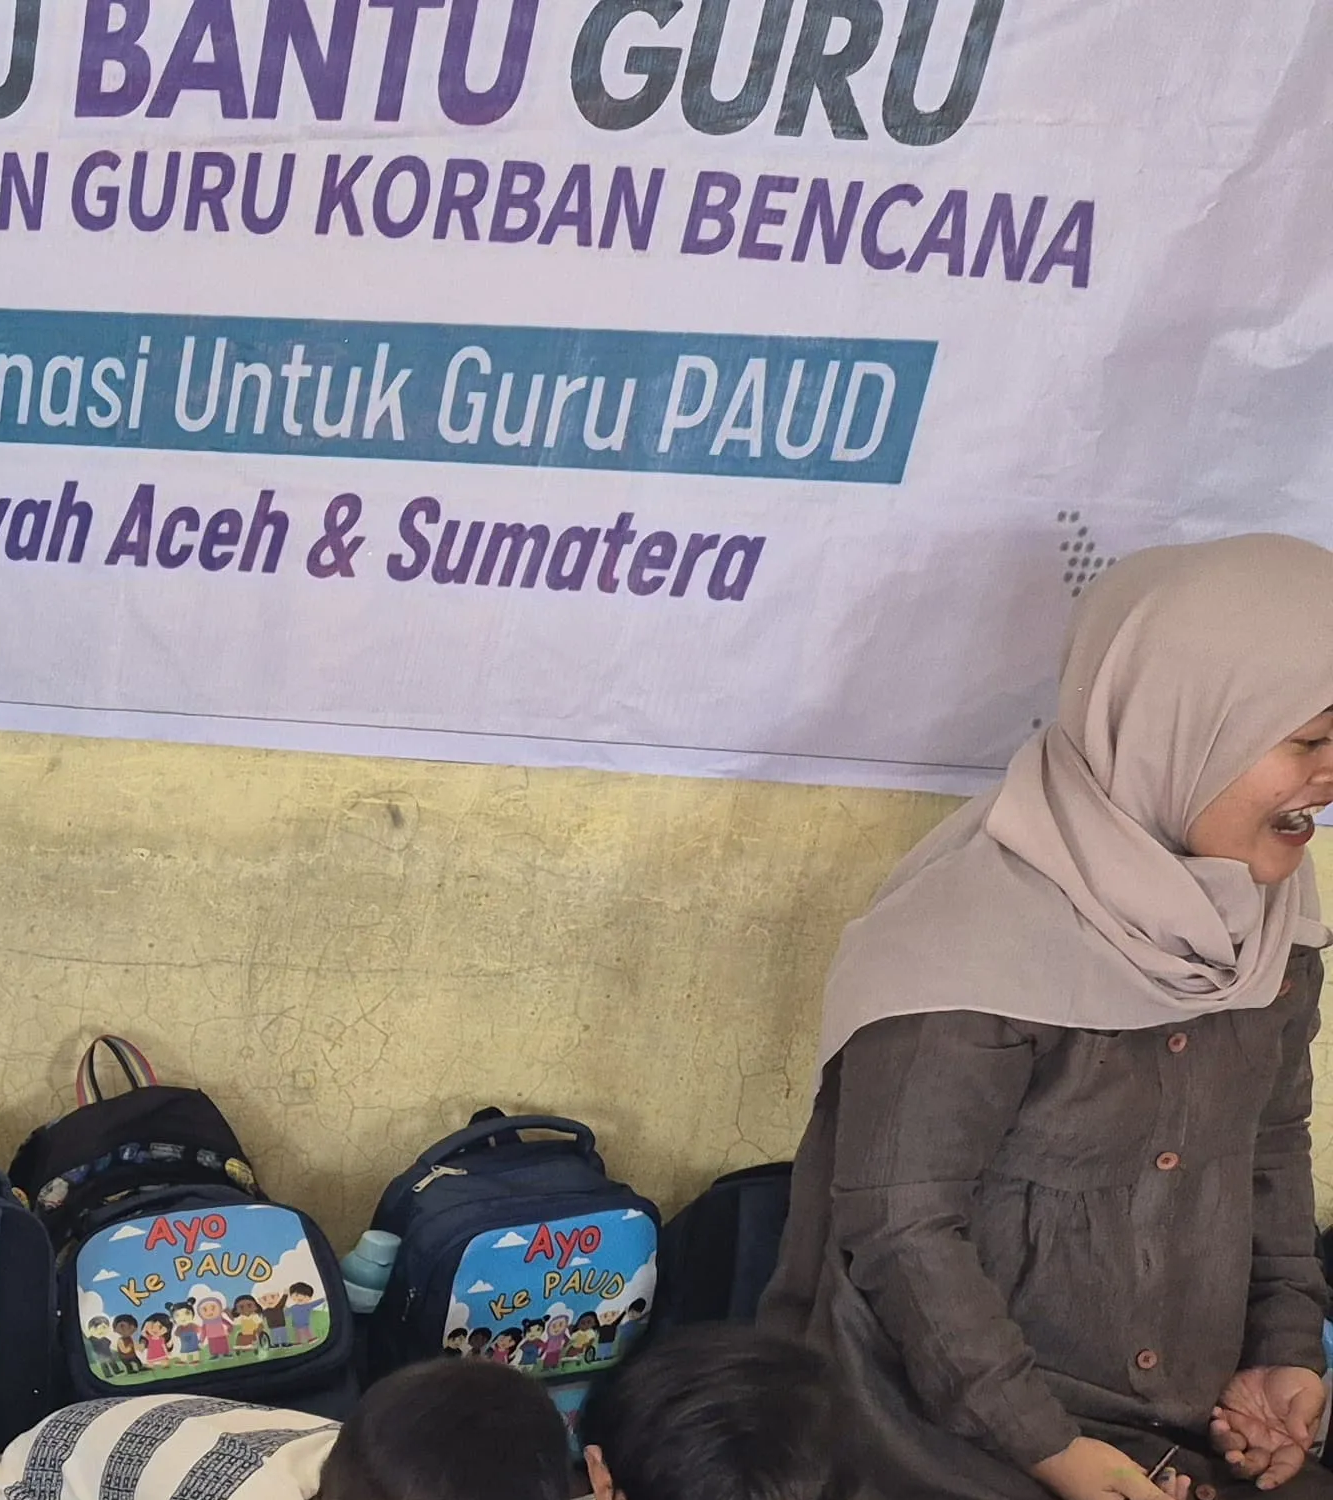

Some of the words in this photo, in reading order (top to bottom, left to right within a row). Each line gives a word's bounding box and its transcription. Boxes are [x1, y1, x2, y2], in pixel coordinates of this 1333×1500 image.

[73, 0, 536, 126] BANTU
[569, 0, 1001, 146] GURU
[71, 150, 298, 236] GURU
[316, 152, 666, 251] KORBAN
[679, 168, 1097, 290] BENCANA
[175, 335, 407, 444] Untuk
[437, 344, 639, 455] Guru
[658, 353, 899, 463] PAUD
[104, 481, 290, 579] Aceh
[306, 492, 364, 580] &
[386, 494, 767, 602] Sumatera
[173, 1252, 272, 1282] PAUD
[543, 1268, 624, 1299] PAUD
